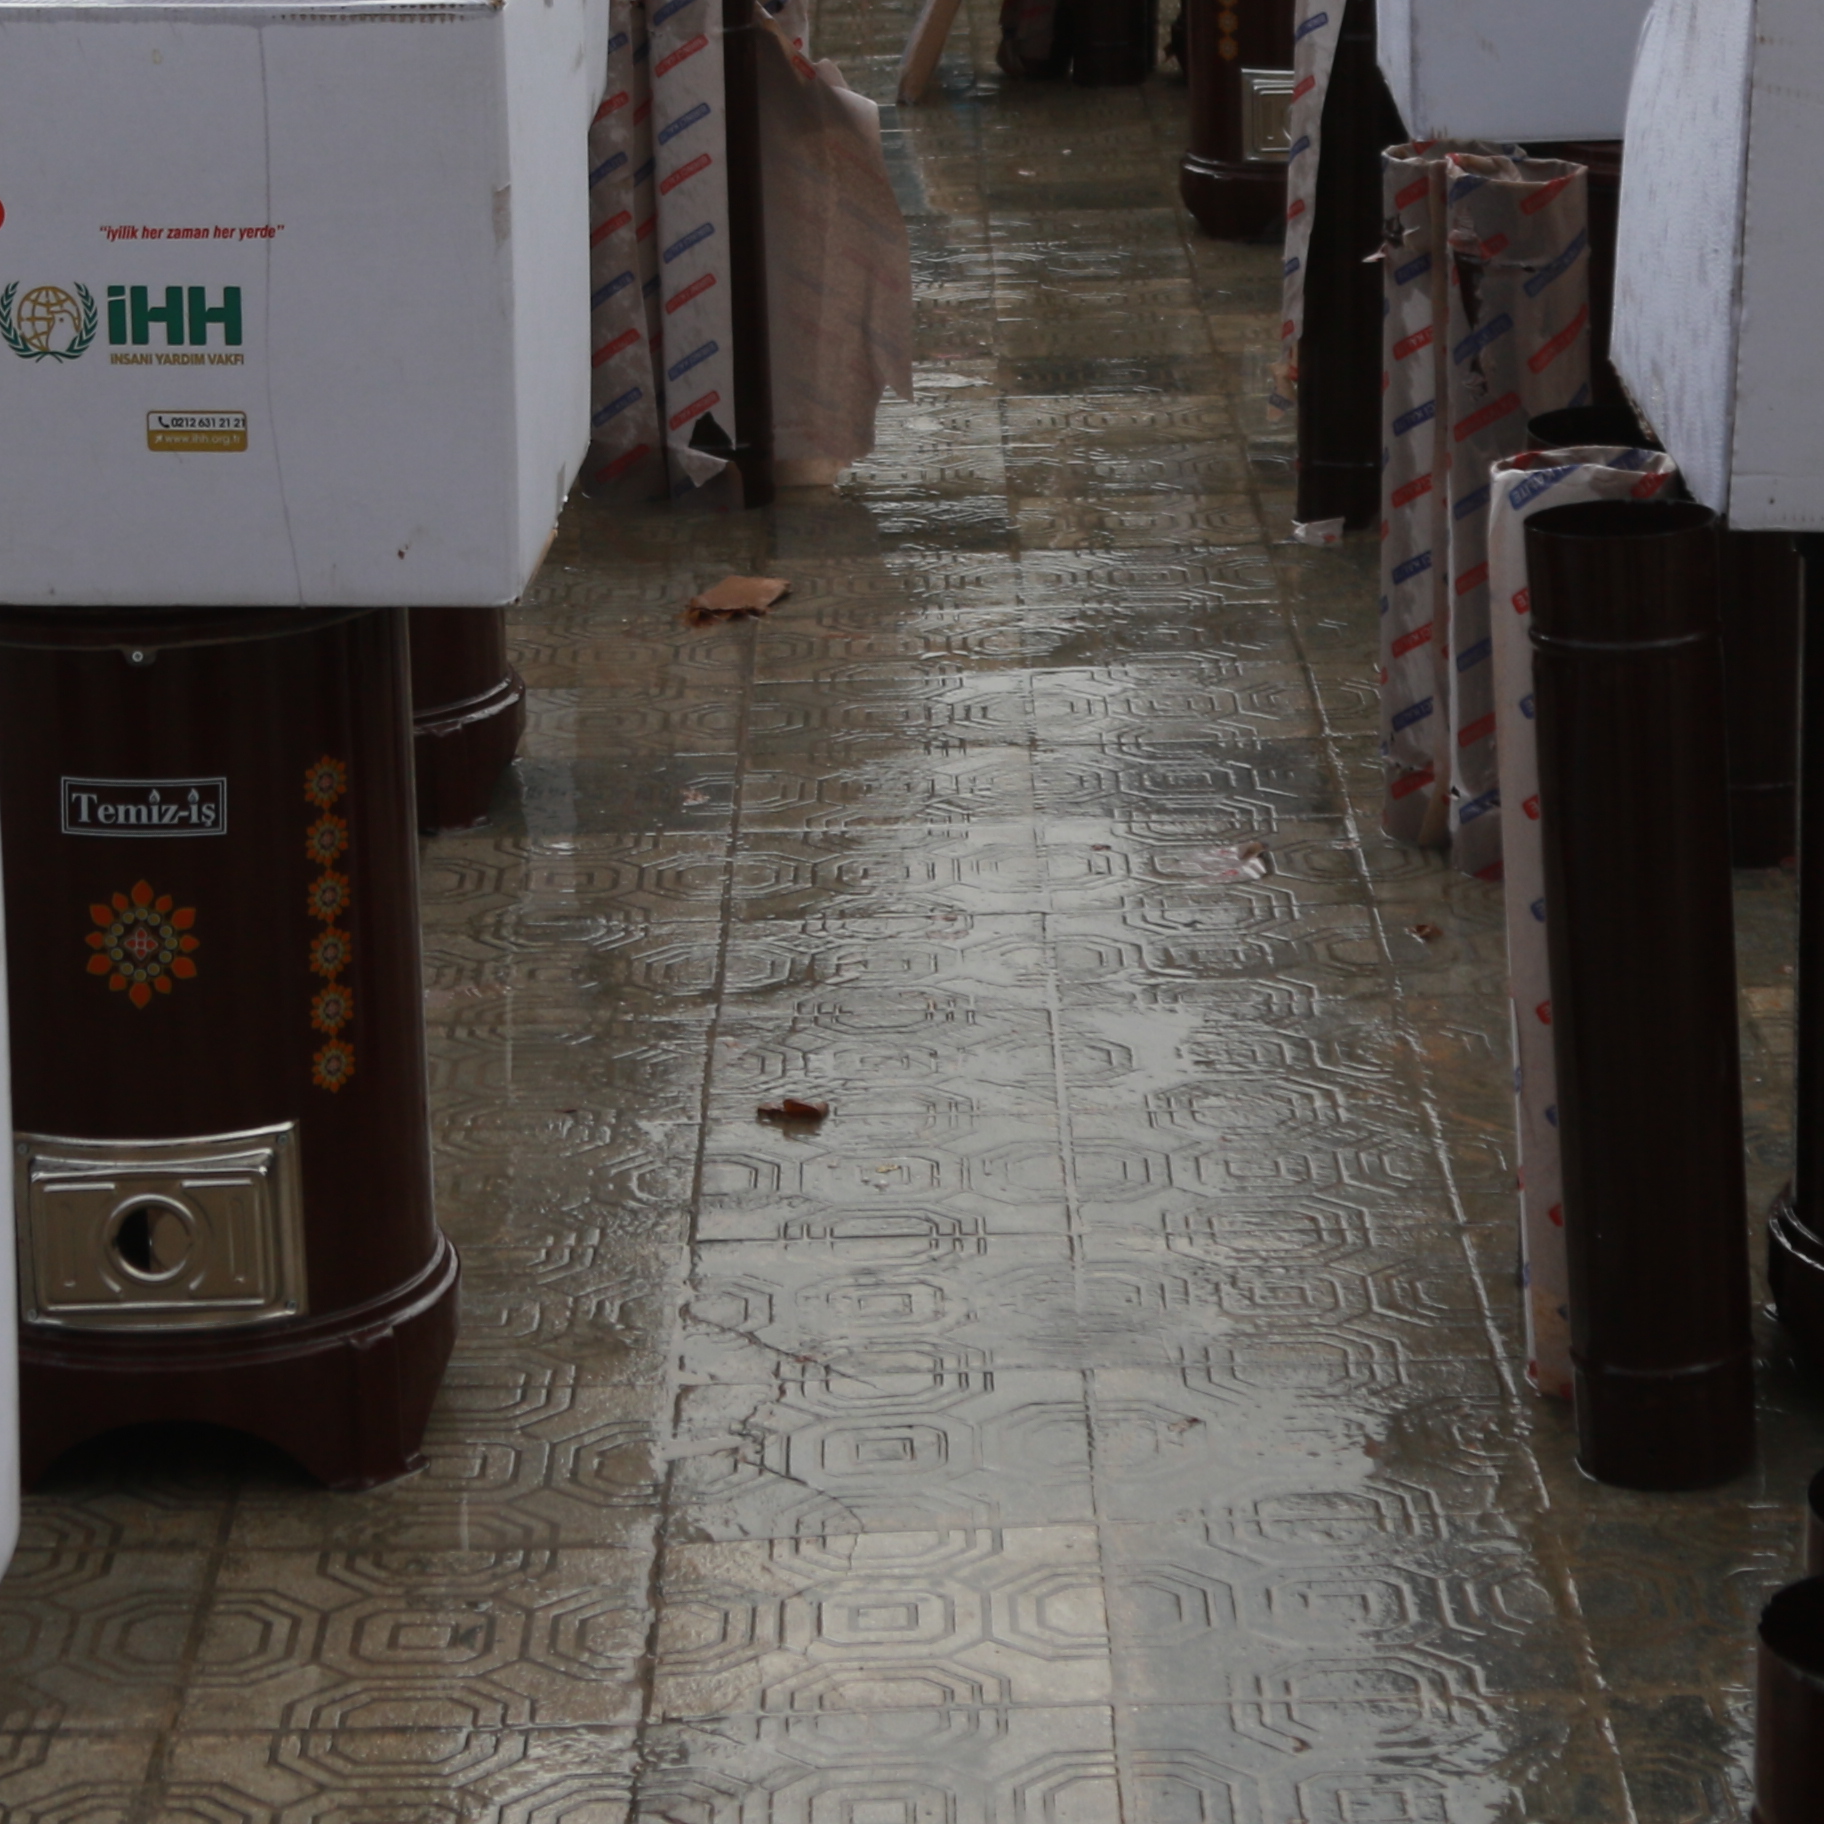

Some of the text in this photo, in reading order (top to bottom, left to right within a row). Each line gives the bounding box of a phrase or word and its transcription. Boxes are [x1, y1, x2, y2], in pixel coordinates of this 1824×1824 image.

[142, 226, 163, 239] her
[167, 228, 208, 239] zaman
[214, 226, 234, 239] her
[155, 353, 205, 365] YARDIM
[208, 353, 244, 365] VAKFI
[171, 417, 245, 428] 0212 631 21 21
[71, 787, 216, 829] Temiz-iş
